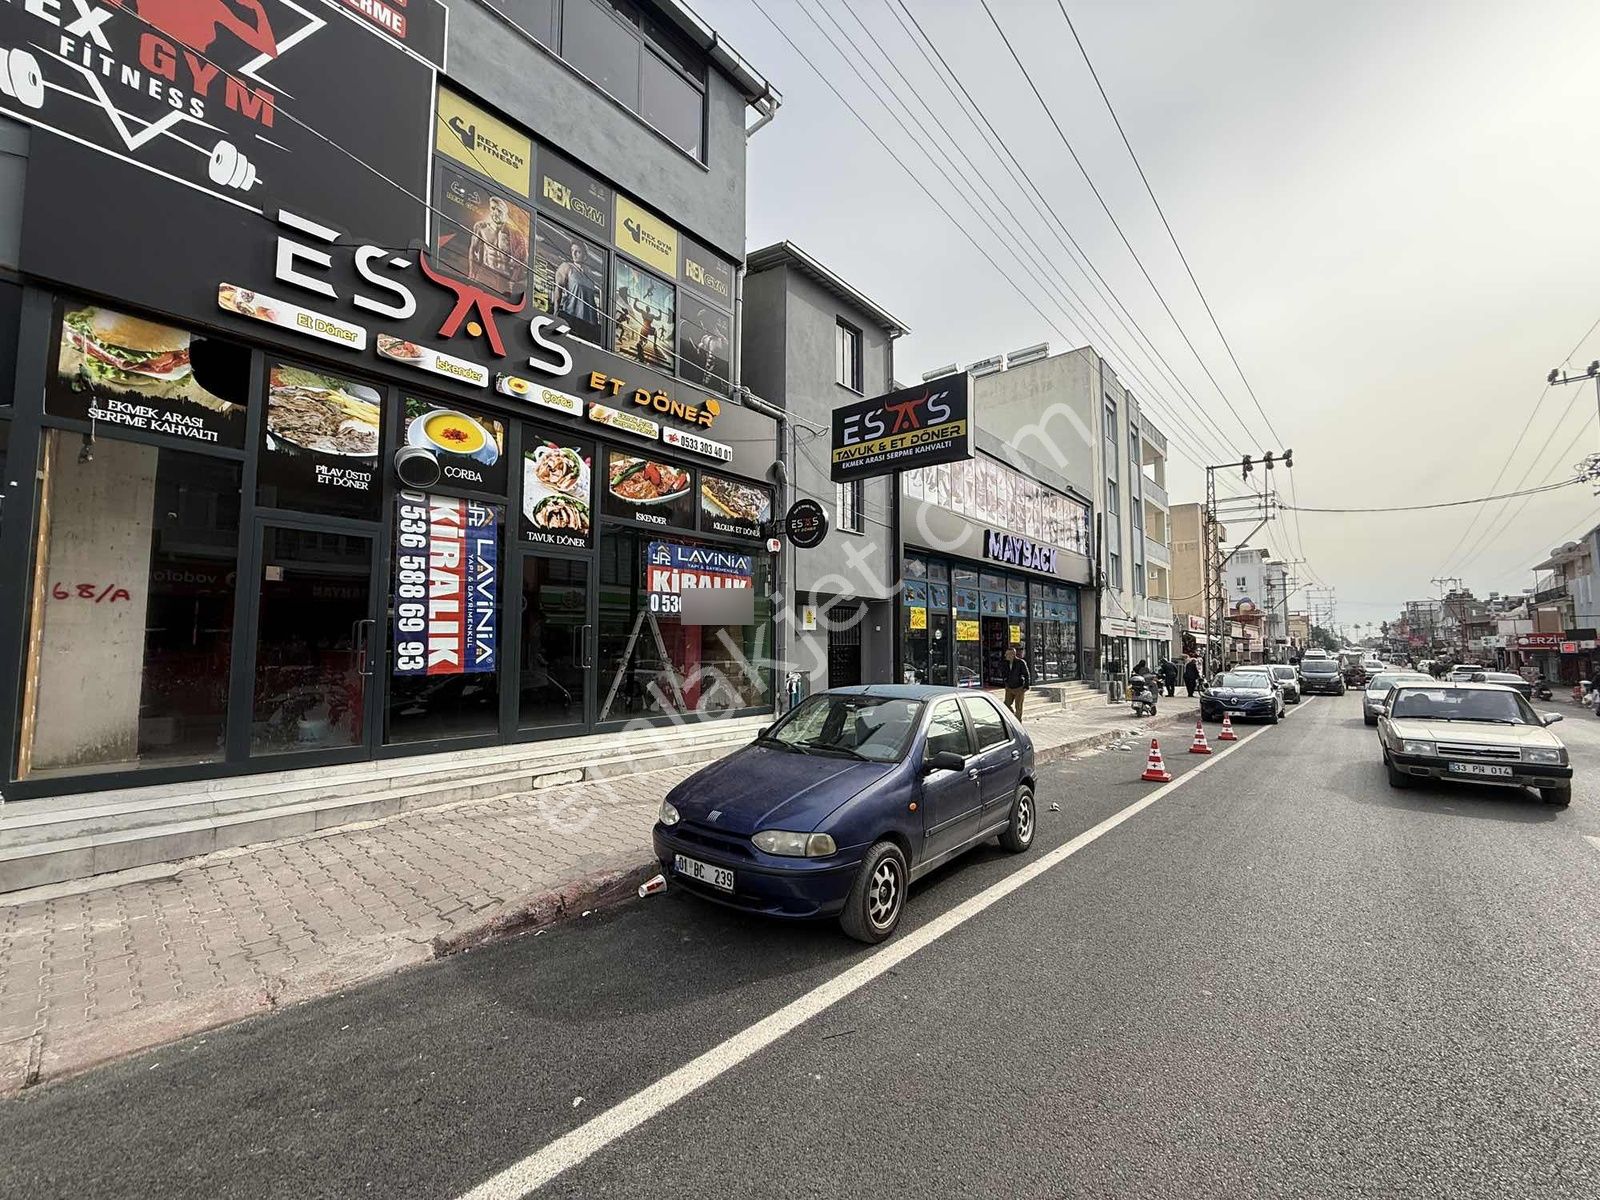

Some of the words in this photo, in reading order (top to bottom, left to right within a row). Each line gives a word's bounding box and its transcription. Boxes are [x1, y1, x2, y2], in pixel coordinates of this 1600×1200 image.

[60, 35, 204, 118] FİTNESS
[138, 32, 275, 128] GYM
[477, 134, 498, 151] REX
[501, 148, 523, 165] GYM
[477, 141, 518, 169] FITNESS
[641, 230, 656, 243] REX
[657, 239, 672, 252] GYM
[641, 236, 669, 256] FITNESS
[297, 313, 313, 330] Et
[315, 319, 358, 342] Döner
[436, 356, 482, 382] İskender
[108, 399, 159, 420] EKMEK
[162, 411, 203, 428] ARASI
[542, 389, 573, 409] Çorba
[590, 371, 626, 395] ET
[635, 388, 714, 428] DÖNER
[88, 407, 148, 428] SERPME
[150, 420, 218, 442] KAHVALTI
[681, 435, 698, 450] 0533
[700, 441, 712, 454] 303
[714, 446, 722, 457] 40
[724, 449, 731, 461] 01
[836, 444, 874, 460] TAVUK
[878, 442, 887, 451] &
[890, 437, 907, 449] ET
[910, 425, 961, 444] DÖNER
[842, 458, 864, 469] EKMEK
[865, 454, 885, 464] ARASI
[886, 448, 913, 460] SERPME
[914, 440, 952, 454] KAHVALTI
[317, 474, 332, 484] ET
[333, 477, 368, 490] DÖNER
[444, 465, 483, 482] ÇORBA
[400, 505, 426, 548] 536
[526, 531, 556, 544] TAVUK
[556, 535, 586, 548] DÖNER
[735, 527, 742, 535] ET
[399, 555, 426, 598] 588
[429, 495, 465, 668] KİRALIK
[650, 593, 659, 612] 0
[661, 594, 682, 612] 53
[398, 603, 425, 632] 69
[397, 641, 425, 670] 93
[1490, 767, 1509, 775] 014
[679, 857, 688, 872] 01
[694, 861, 705, 879] BC
[714, 869, 732, 888] 239
